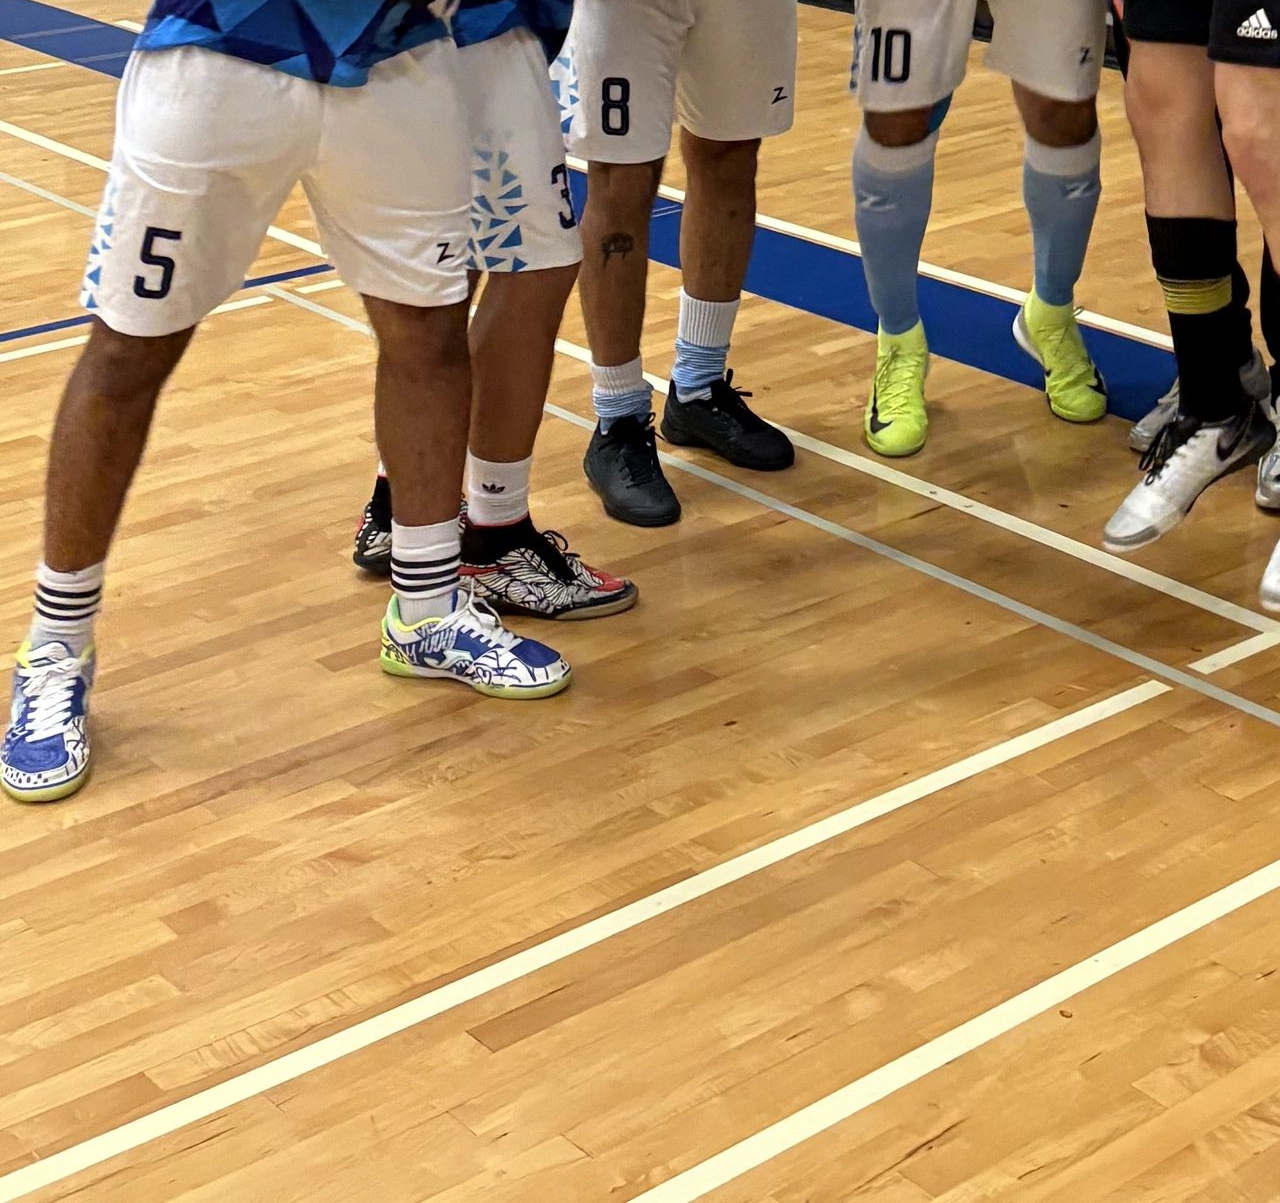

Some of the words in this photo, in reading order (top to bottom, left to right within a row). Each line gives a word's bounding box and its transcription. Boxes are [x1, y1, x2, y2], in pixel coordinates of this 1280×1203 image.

[870, 26, 912, 84] 10
[1236, 26, 1278, 40] adidas
[600, 76, 631, 136] 8
[132, 225, 182, 300] 5
